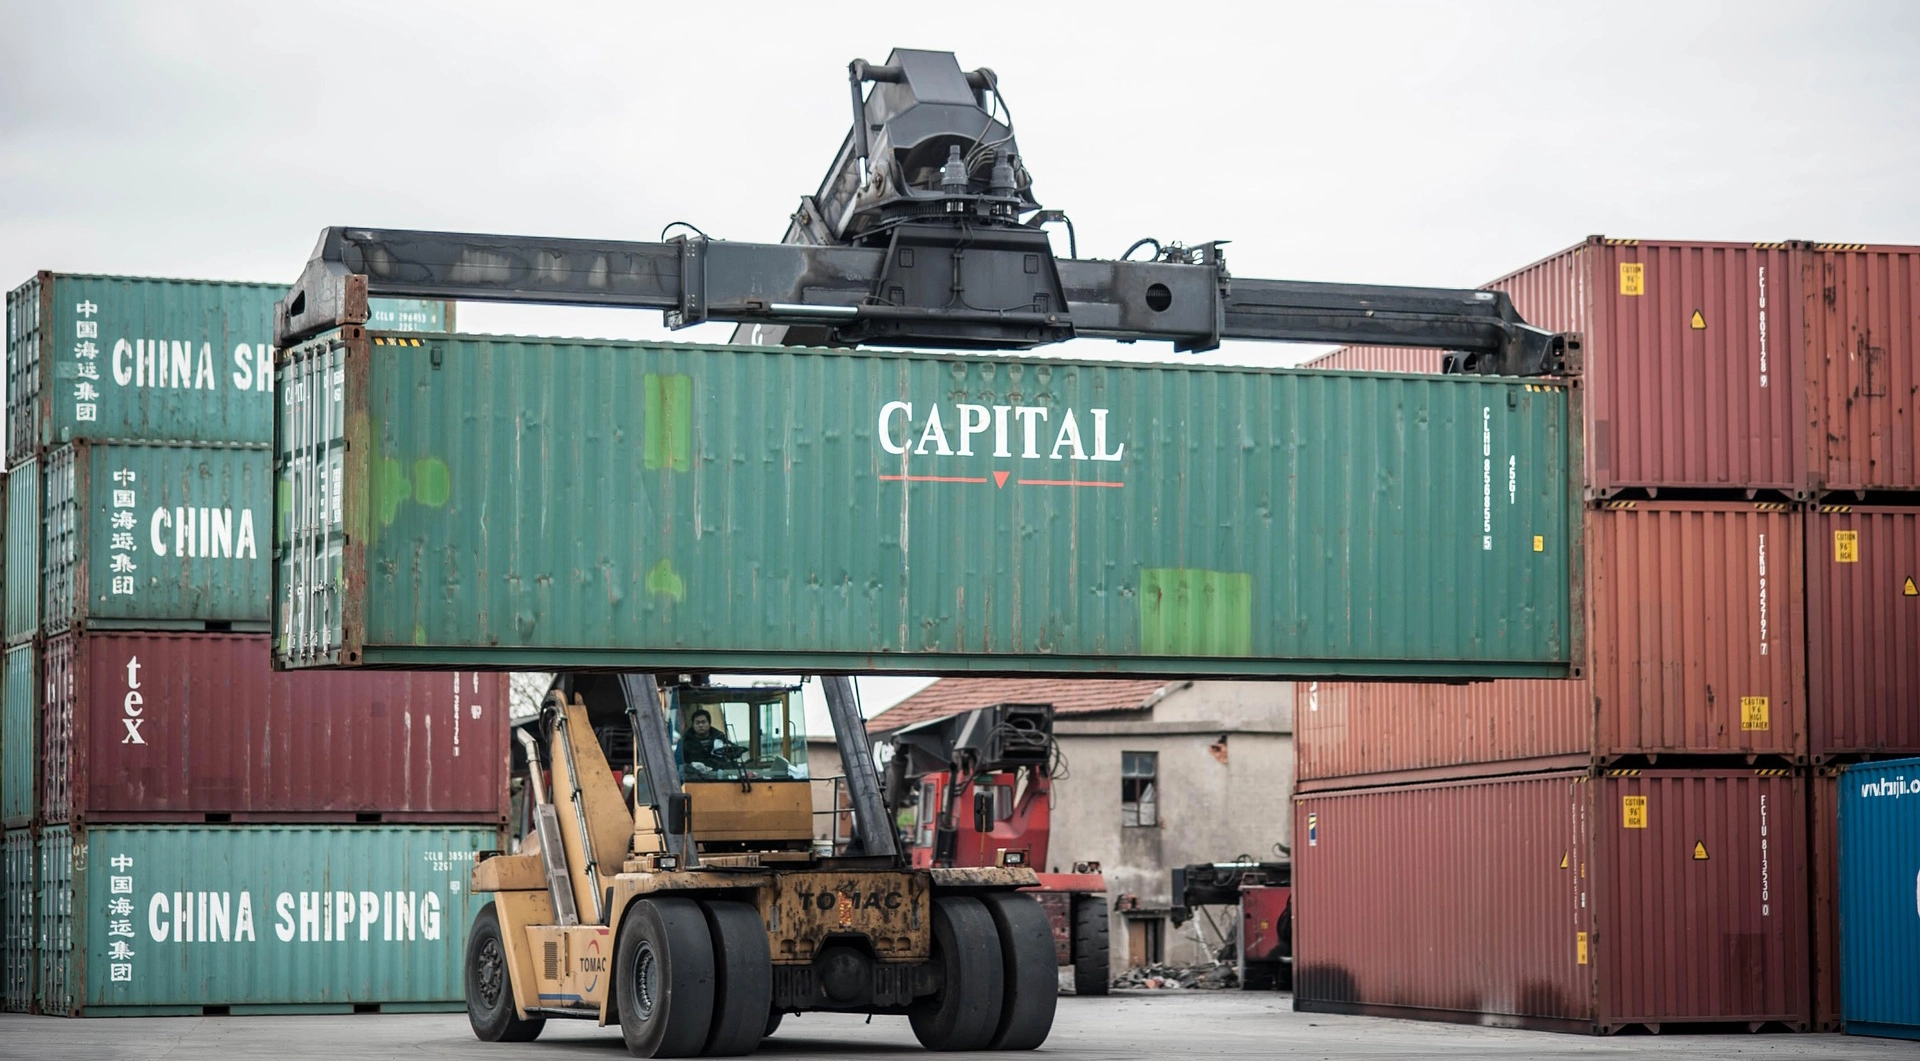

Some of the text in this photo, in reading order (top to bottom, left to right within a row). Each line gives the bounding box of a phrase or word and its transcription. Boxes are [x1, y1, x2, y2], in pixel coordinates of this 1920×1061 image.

[73, 299, 100, 422] 中国海运集团
[112, 338, 215, 390] CHINA
[1761, 375, 1767, 387] 9
[878, 401, 1125, 462] CAPITAL
[151, 506, 257, 559] CHINA
[1484, 536, 1491, 550] 5
[1761, 643, 1767, 655] 7
[121, 655, 146, 744] tex
[108, 853, 135, 982] 中国海运集团
[149, 891, 441, 942] CHINA SHIPPING
[1763, 904, 1769, 916] 0
[580, 957, 607, 972] TOMAC
